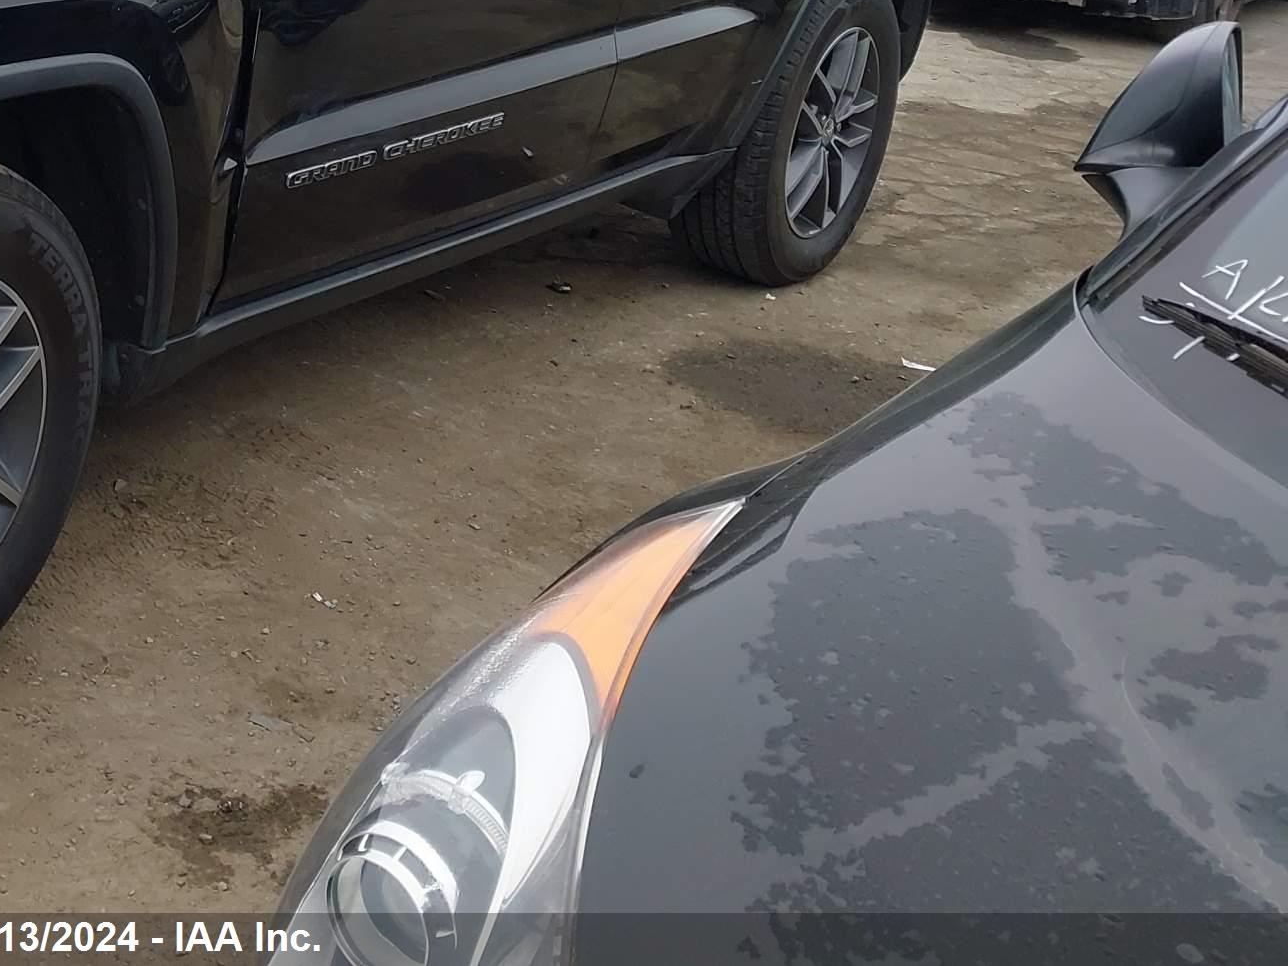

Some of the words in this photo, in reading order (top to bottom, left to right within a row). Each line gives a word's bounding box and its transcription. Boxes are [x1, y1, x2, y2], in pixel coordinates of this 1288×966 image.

[286, 150, 378, 189] GRAND
[383, 112, 505, 161] CHEROKEE
[27, 228, 88, 339] TERRA
